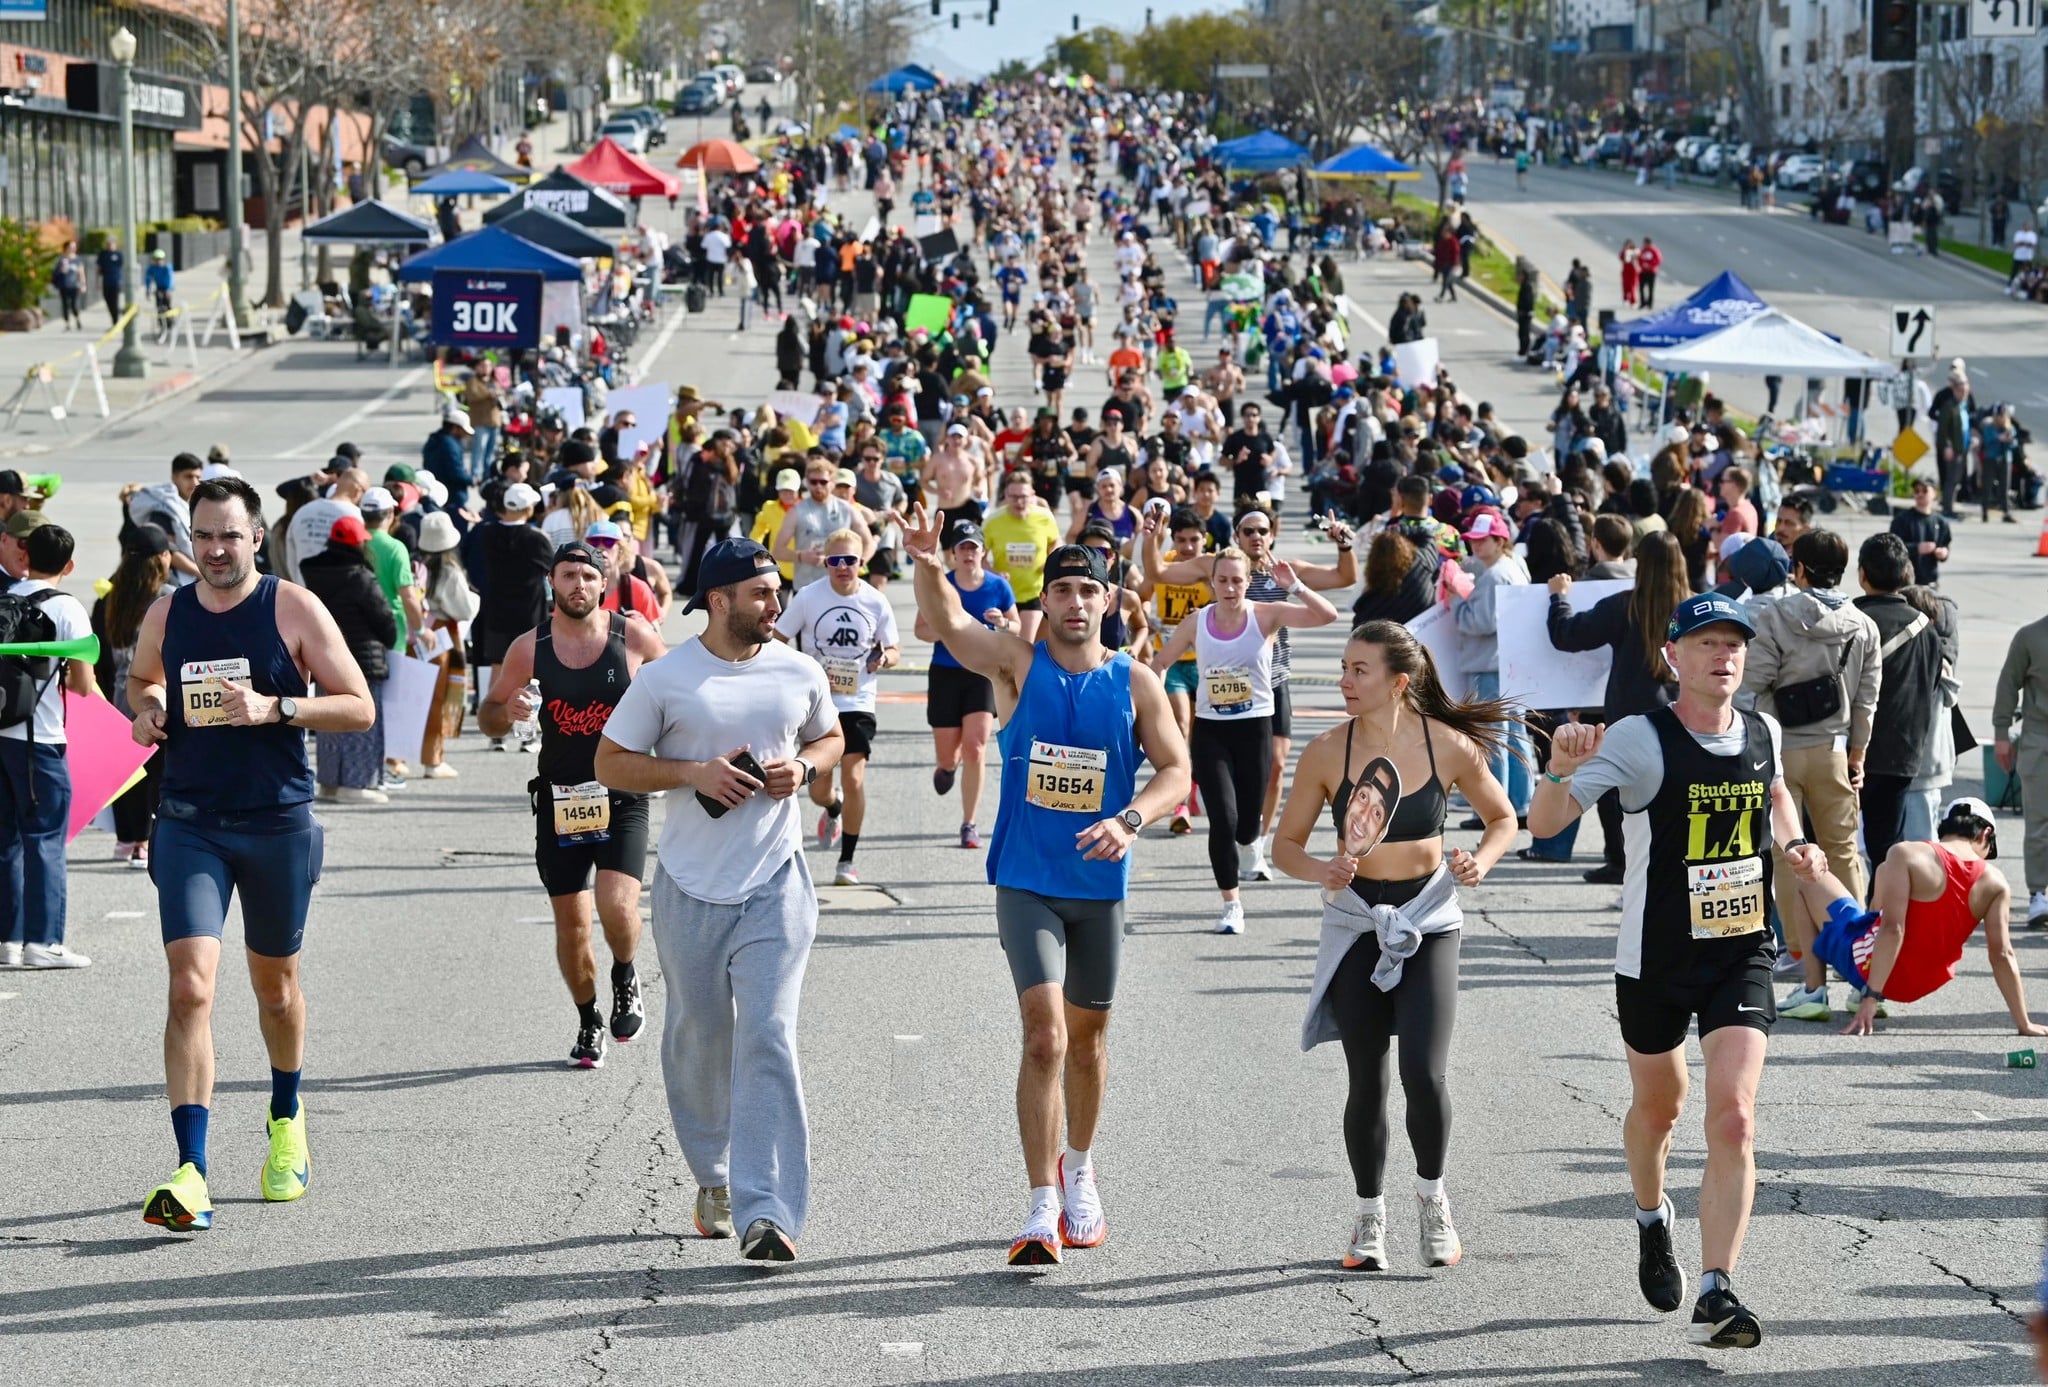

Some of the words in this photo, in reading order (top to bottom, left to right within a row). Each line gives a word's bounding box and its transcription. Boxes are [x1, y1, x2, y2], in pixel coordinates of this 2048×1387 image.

[452, 301, 519, 333] 30K
[826, 627, 859, 647] AR
[546, 698, 614, 724] Venice
[1037, 774, 1094, 794] 13654
[1688, 780, 1764, 799] Students
[562, 805, 602, 820] 14541
[1687, 795, 1764, 813] run
[1684, 810, 1755, 861] LA
[1701, 894, 1758, 920] B2551
